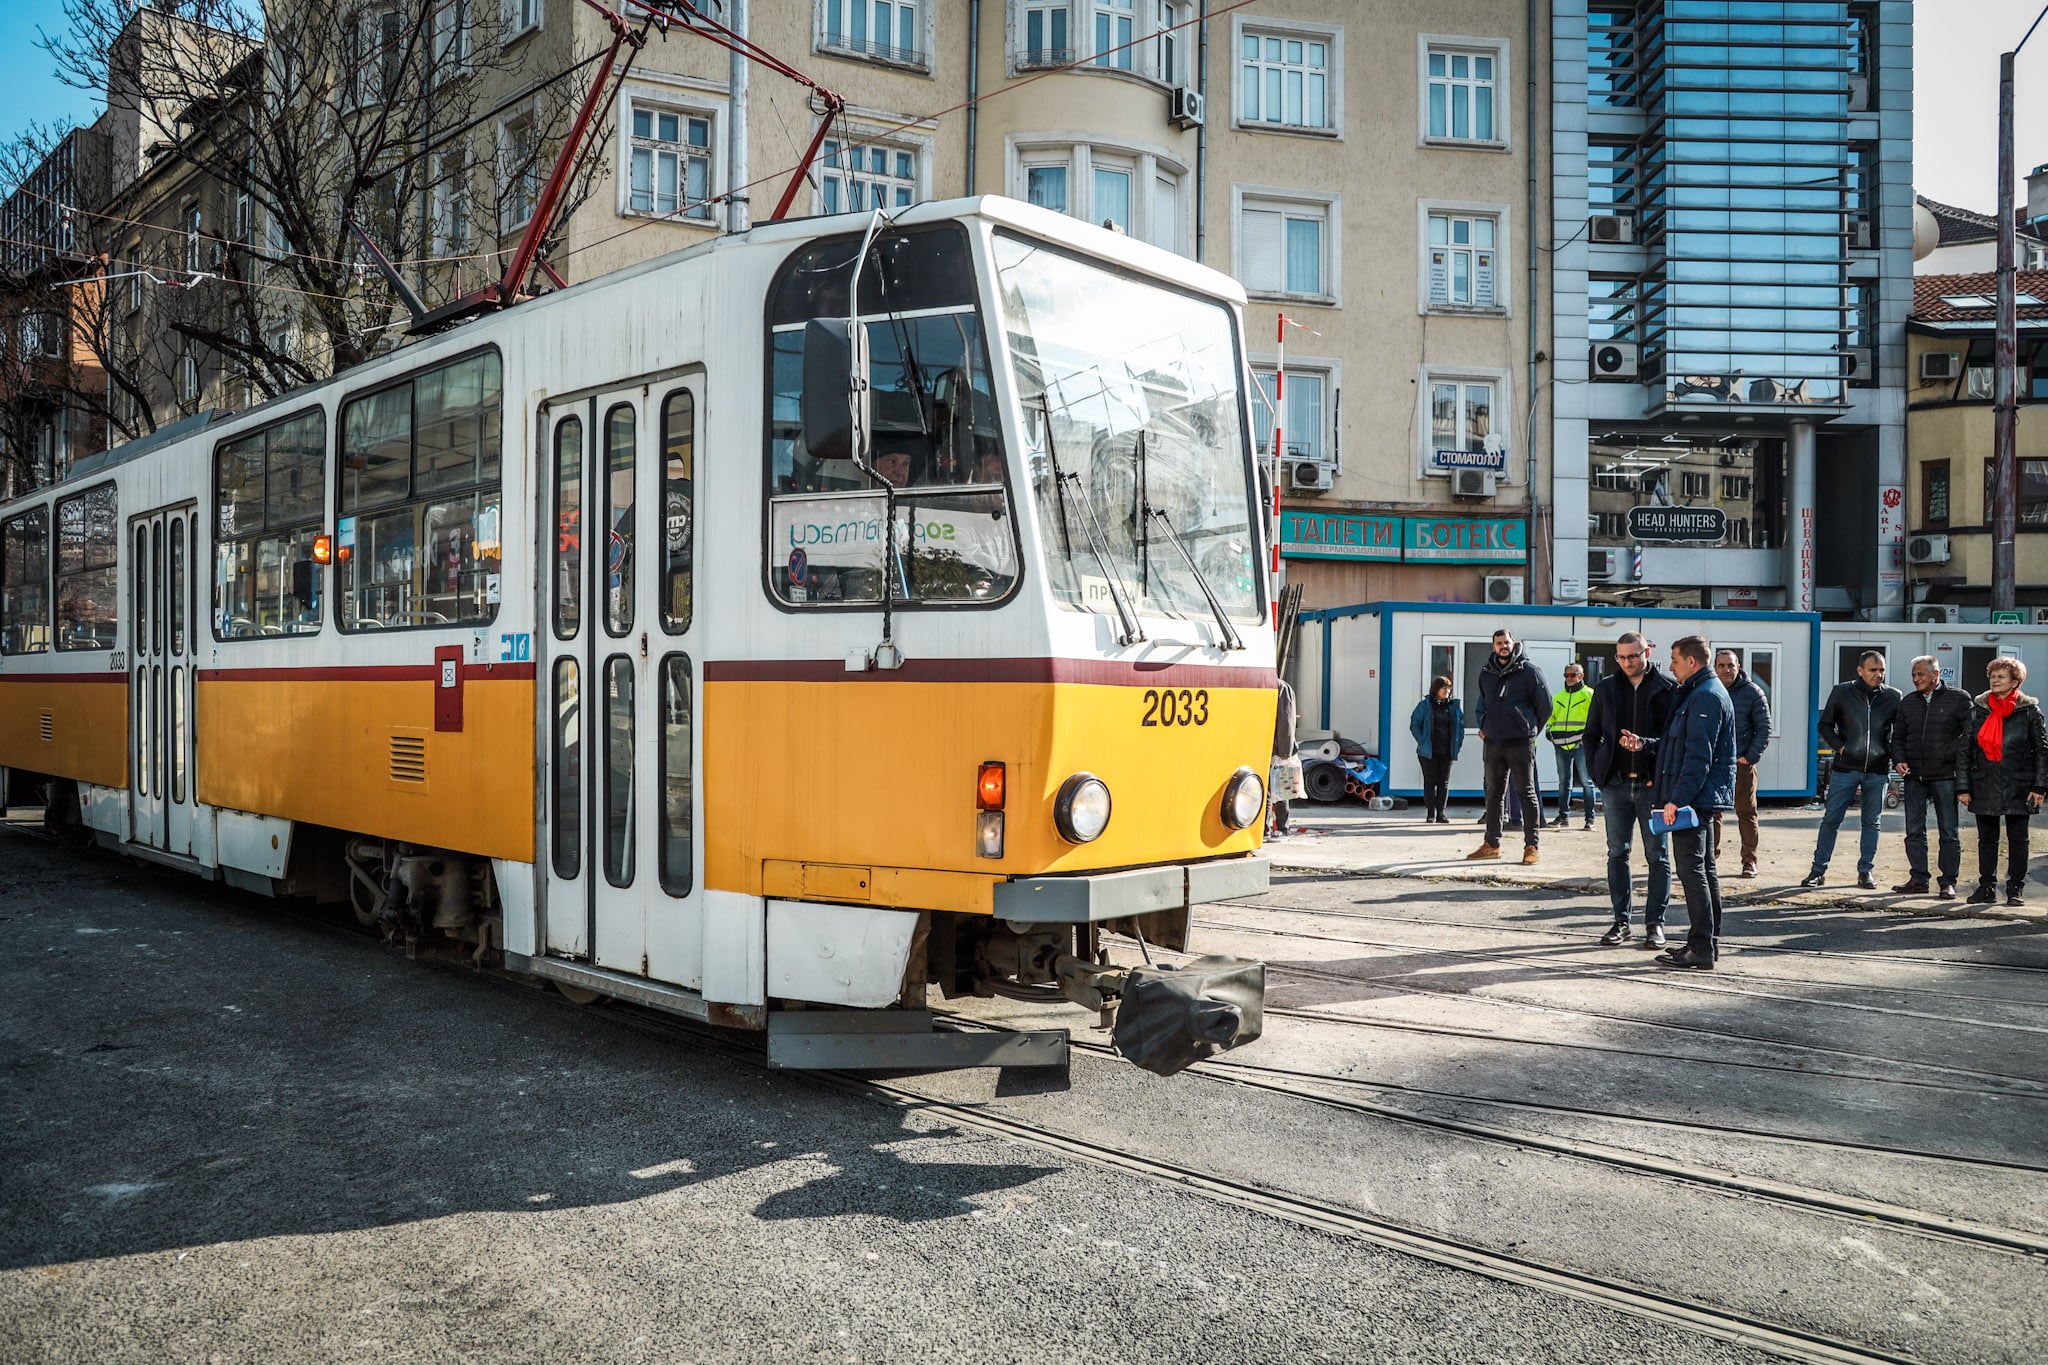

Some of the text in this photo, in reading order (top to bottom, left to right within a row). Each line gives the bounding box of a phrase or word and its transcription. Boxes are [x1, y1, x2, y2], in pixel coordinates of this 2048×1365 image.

[1440, 452, 1503, 466] СТОМАТОЛОГ
[1290, 516, 1392, 545] ТАПЕТИ
[1637, 513, 1716, 528] HEAD HUNTERS
[1881, 508, 1889, 534] ART
[1416, 522, 1516, 548] БОТЕКС
[1801, 508, 1812, 579] ШИВАШКИ
[1894, 524, 1903, 567] SHOP
[110, 652, 124, 670] 2033
[1142, 690, 1208, 726] 2033
